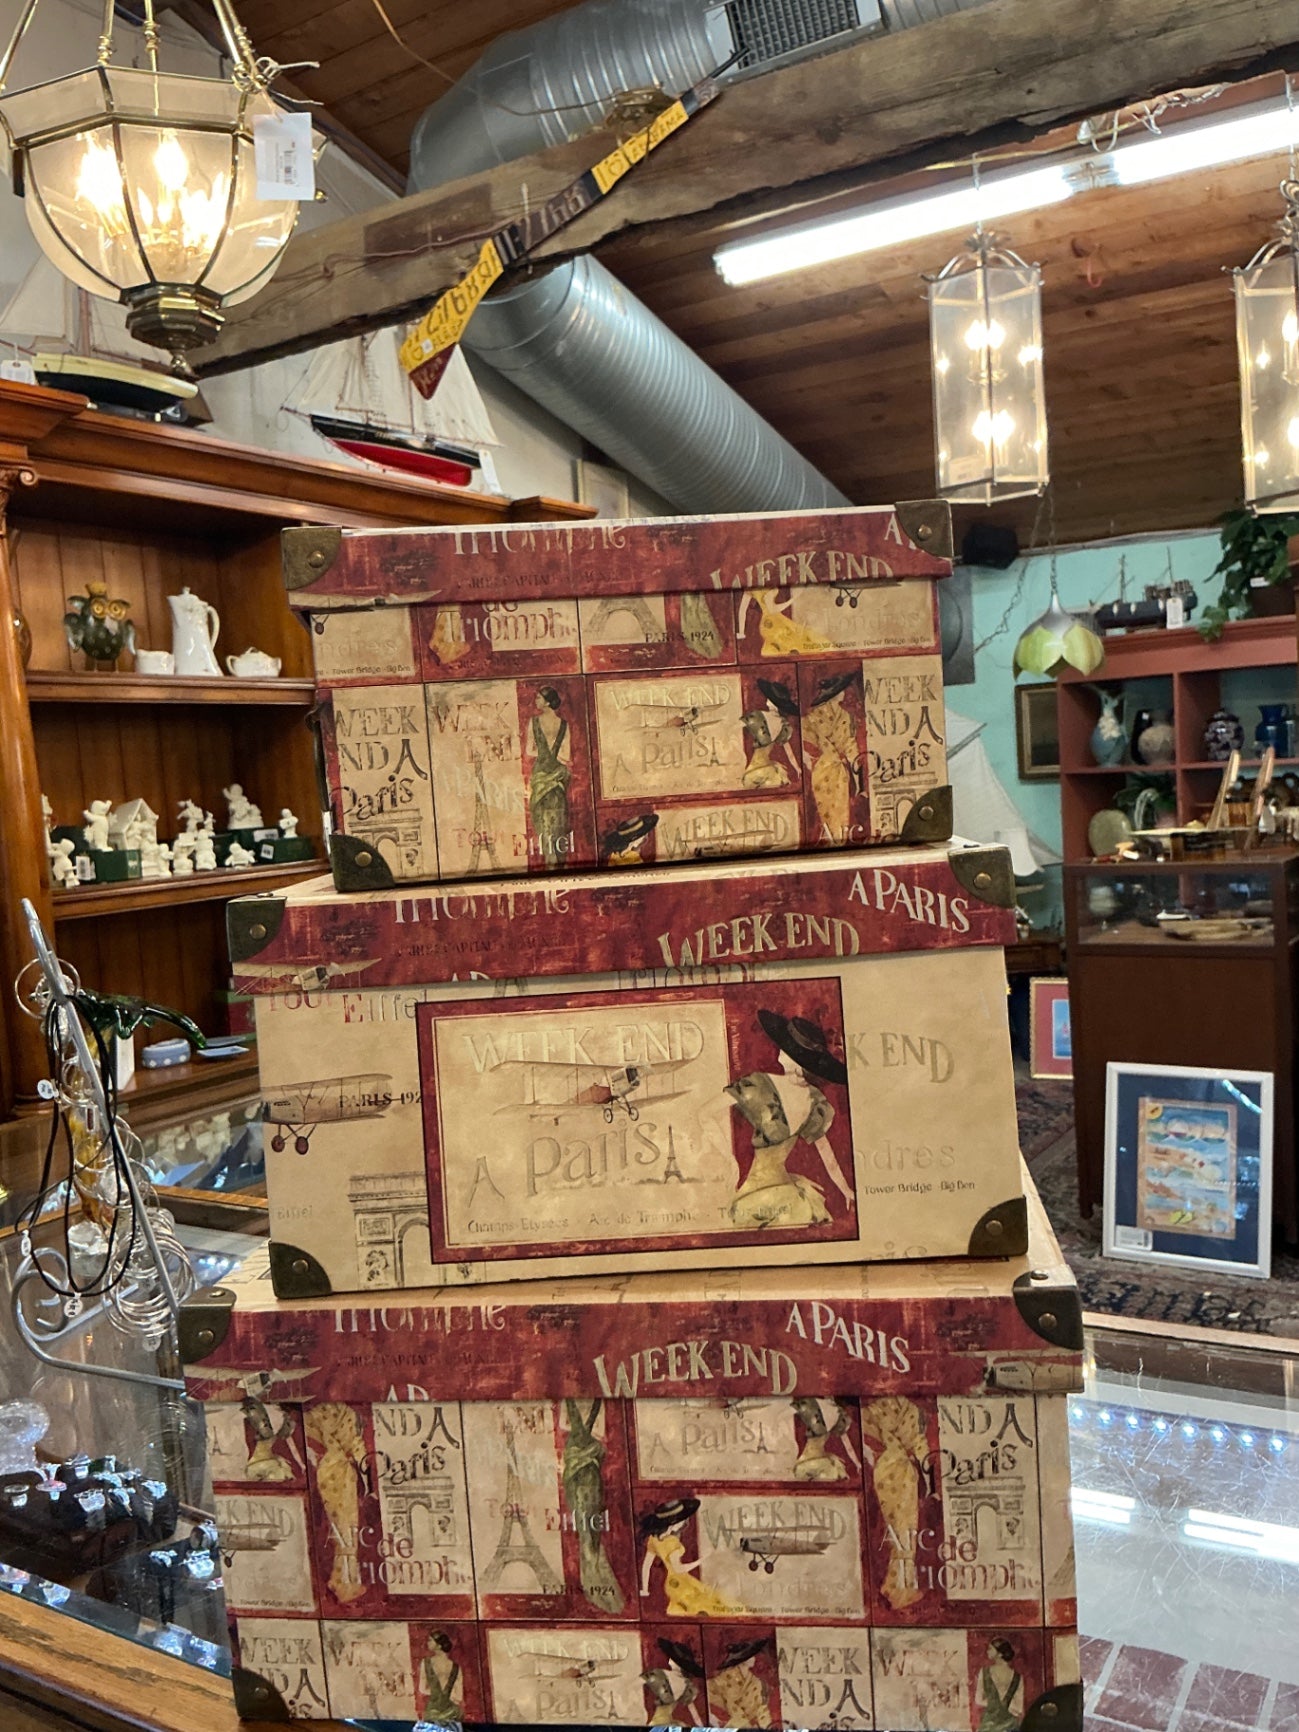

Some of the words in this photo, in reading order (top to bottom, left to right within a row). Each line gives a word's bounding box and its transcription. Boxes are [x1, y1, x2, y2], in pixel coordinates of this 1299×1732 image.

[690, 631, 715, 642] 1924
[851, 740, 931, 798] Paris
[657, 912, 778, 967] WEEK
[784, 911, 860, 957] END
[462, 1025, 601, 1074] WEEK
[615, 1020, 705, 1065] END
[880, 1031, 955, 1084] END
[526, 1118, 661, 1198] Paris
[864, 1185, 895, 1195] Tower
[898, 1182, 933, 1194] Bridge
[589, 1212, 610, 1226] Ac
[593, 1340, 713, 1398] WEEK
[720, 1340, 798, 1396] END
[359, 1441, 447, 1501] Paris
[921, 1440, 1018, 1501] Paris
